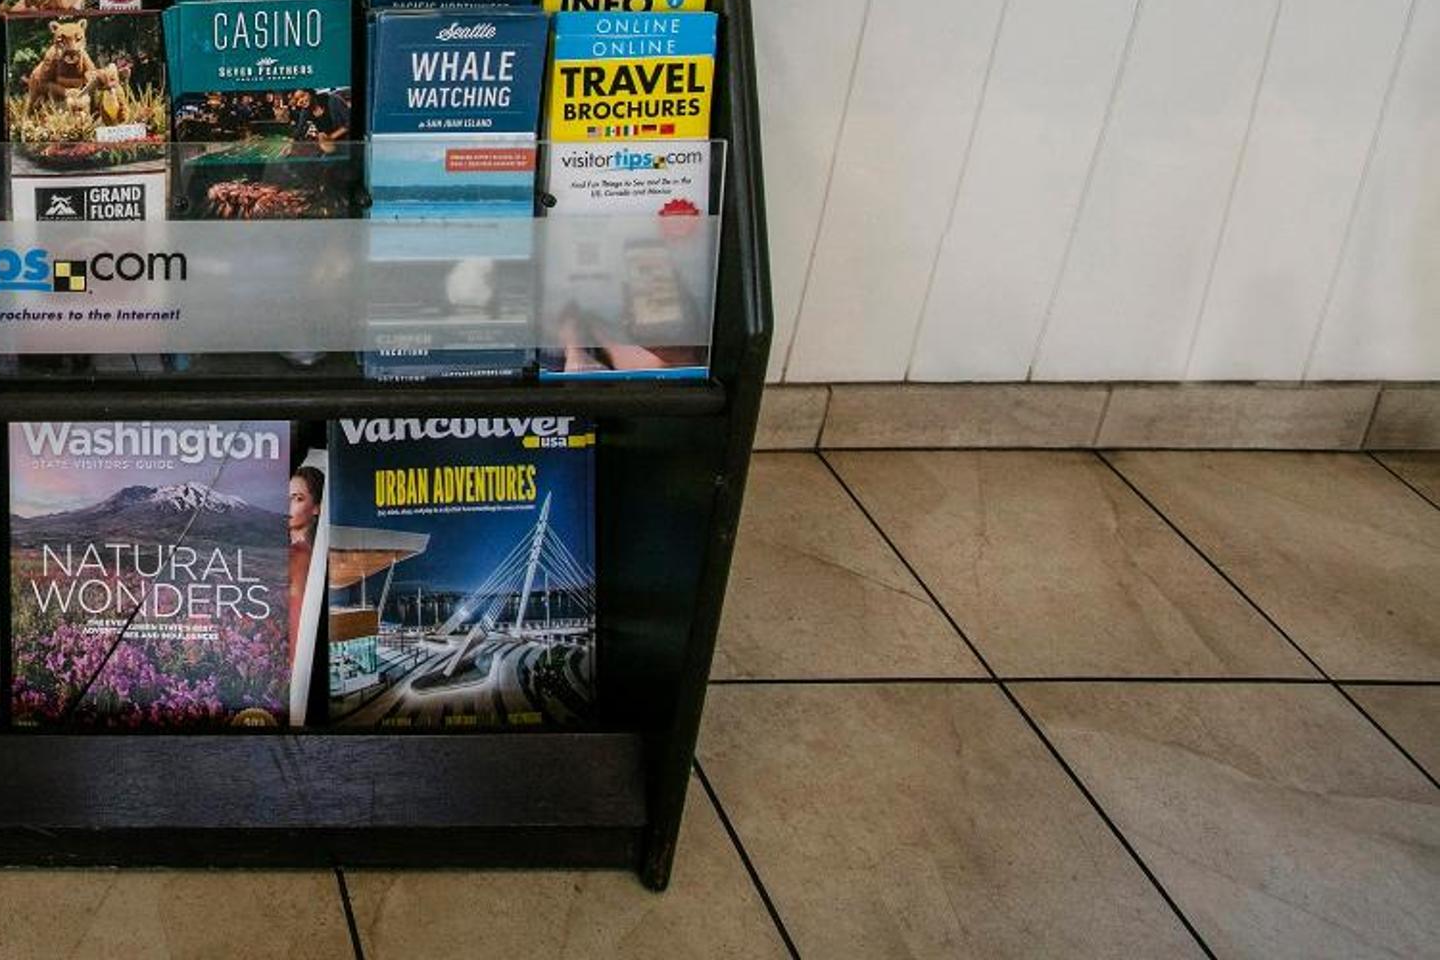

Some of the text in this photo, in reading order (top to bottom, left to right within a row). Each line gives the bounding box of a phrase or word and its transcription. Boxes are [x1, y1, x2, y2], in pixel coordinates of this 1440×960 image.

[214, 9, 322, 50] CASINO
[436, 22, 496, 40] Seattle
[593, 40, 677, 57] ONLINE
[258, 65, 314, 77] FEATHERS
[412, 51, 516, 83] WHALE
[560, 62, 705, 97] TRAVEL
[408, 87, 512, 109] WATCHING
[563, 98, 700, 121] BROCHURES
[90, 188, 141, 203] GRAND
[90, 204, 141, 220] FLORAL
[68, 309, 83, 321] to
[89, 308, 111, 321] the
[117, 308, 180, 321] Internet!
[22, 422, 280, 464] Washington
[541, 437, 567, 448] usa
[376, 464, 536, 507] URBAN ADVENTURES
[43, 543, 260, 583] NATURAL
[31, 580, 271, 620] WONDERS
